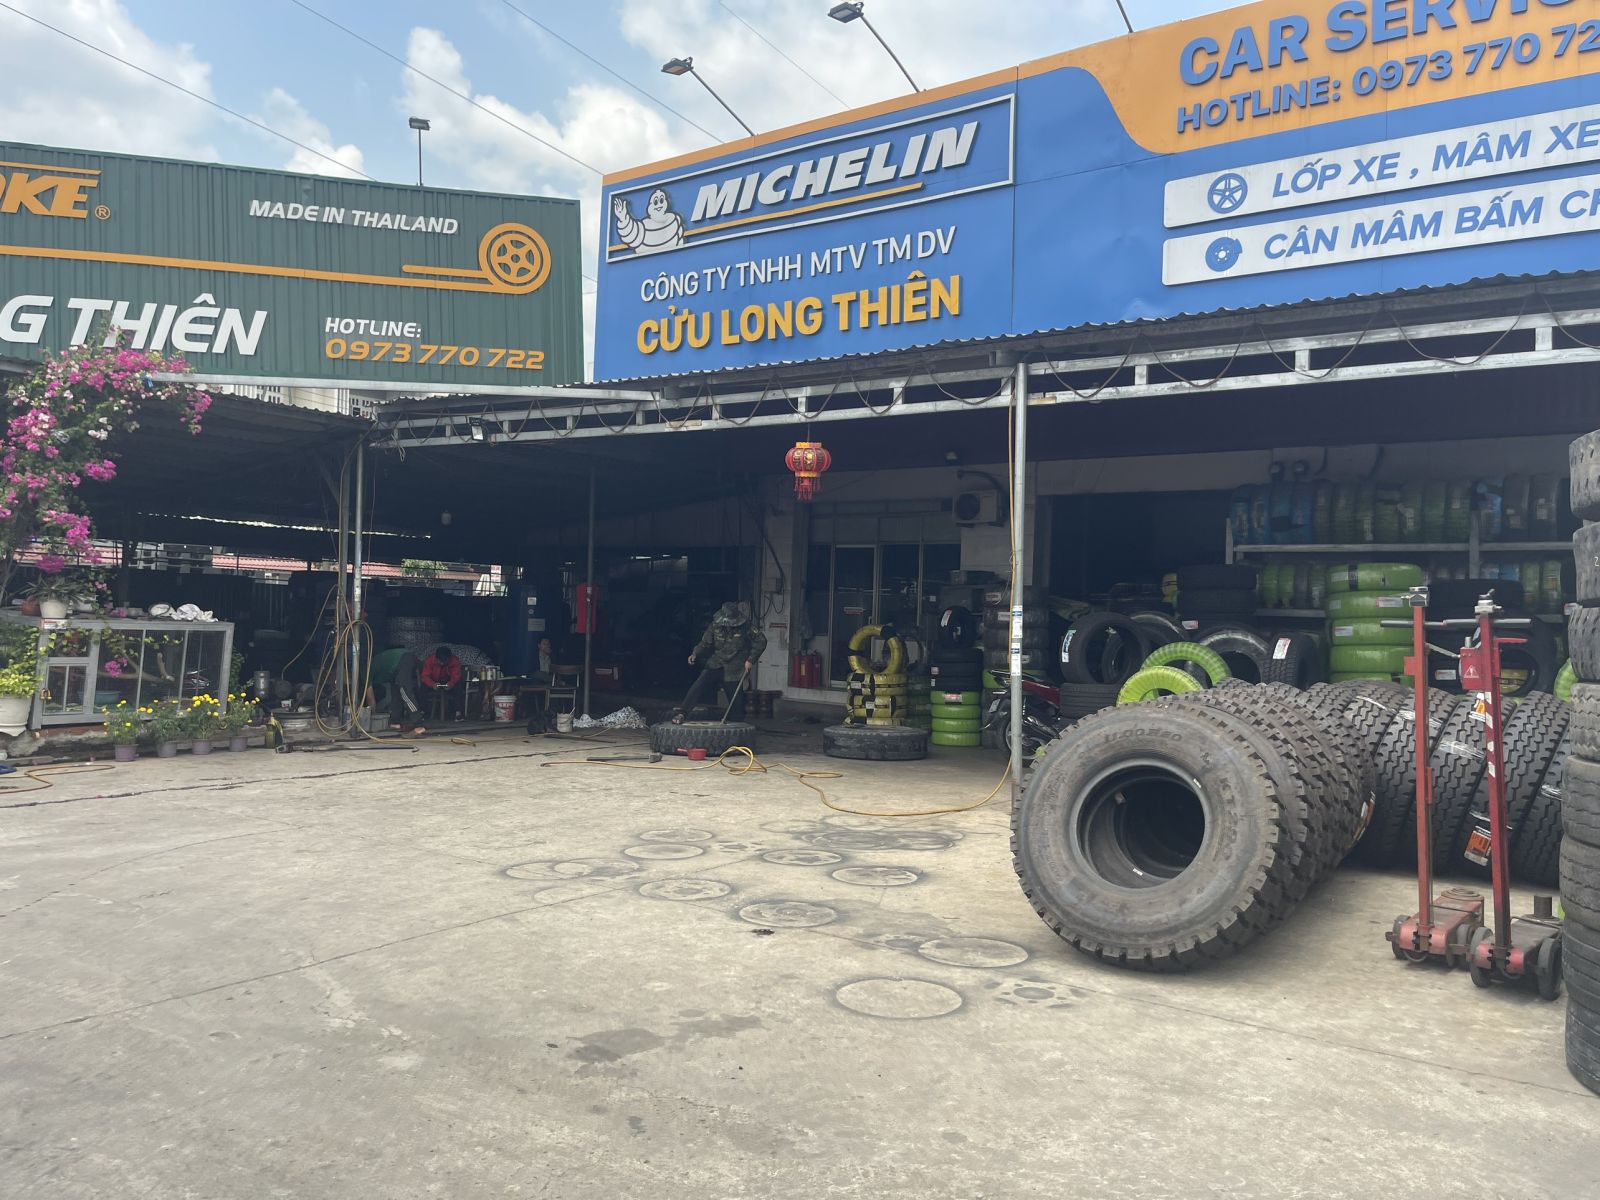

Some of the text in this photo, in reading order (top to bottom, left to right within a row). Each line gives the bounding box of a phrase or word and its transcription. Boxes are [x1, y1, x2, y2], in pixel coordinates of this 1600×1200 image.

[1177, 76, 1341, 133] HOTLINE:
[1352, 50, 1453, 96] 0973
[1463, 32, 1541, 76] 770
[1179, 15, 1309, 86] CAR
[690, 121, 980, 222] MICHELIN
[1272, 158, 1341, 199] LỐP
[1432, 130, 1531, 172] MÂM
[249, 200, 459, 235] MADE IN THAILAND
[1264, 226, 1339, 260] CÂN
[1350, 210, 1441, 250] MÂM
[1454, 190, 1544, 235] BẤM
[640, 226, 957, 302] CÔNG TY TNHH MTV TM DV
[67, 293, 267, 356] THIÊN
[325, 317, 421, 339] HOTLINE:
[636, 270, 961, 355] CỬU LONG THIÊN
[325, 338, 545, 370] 0973 770 722
